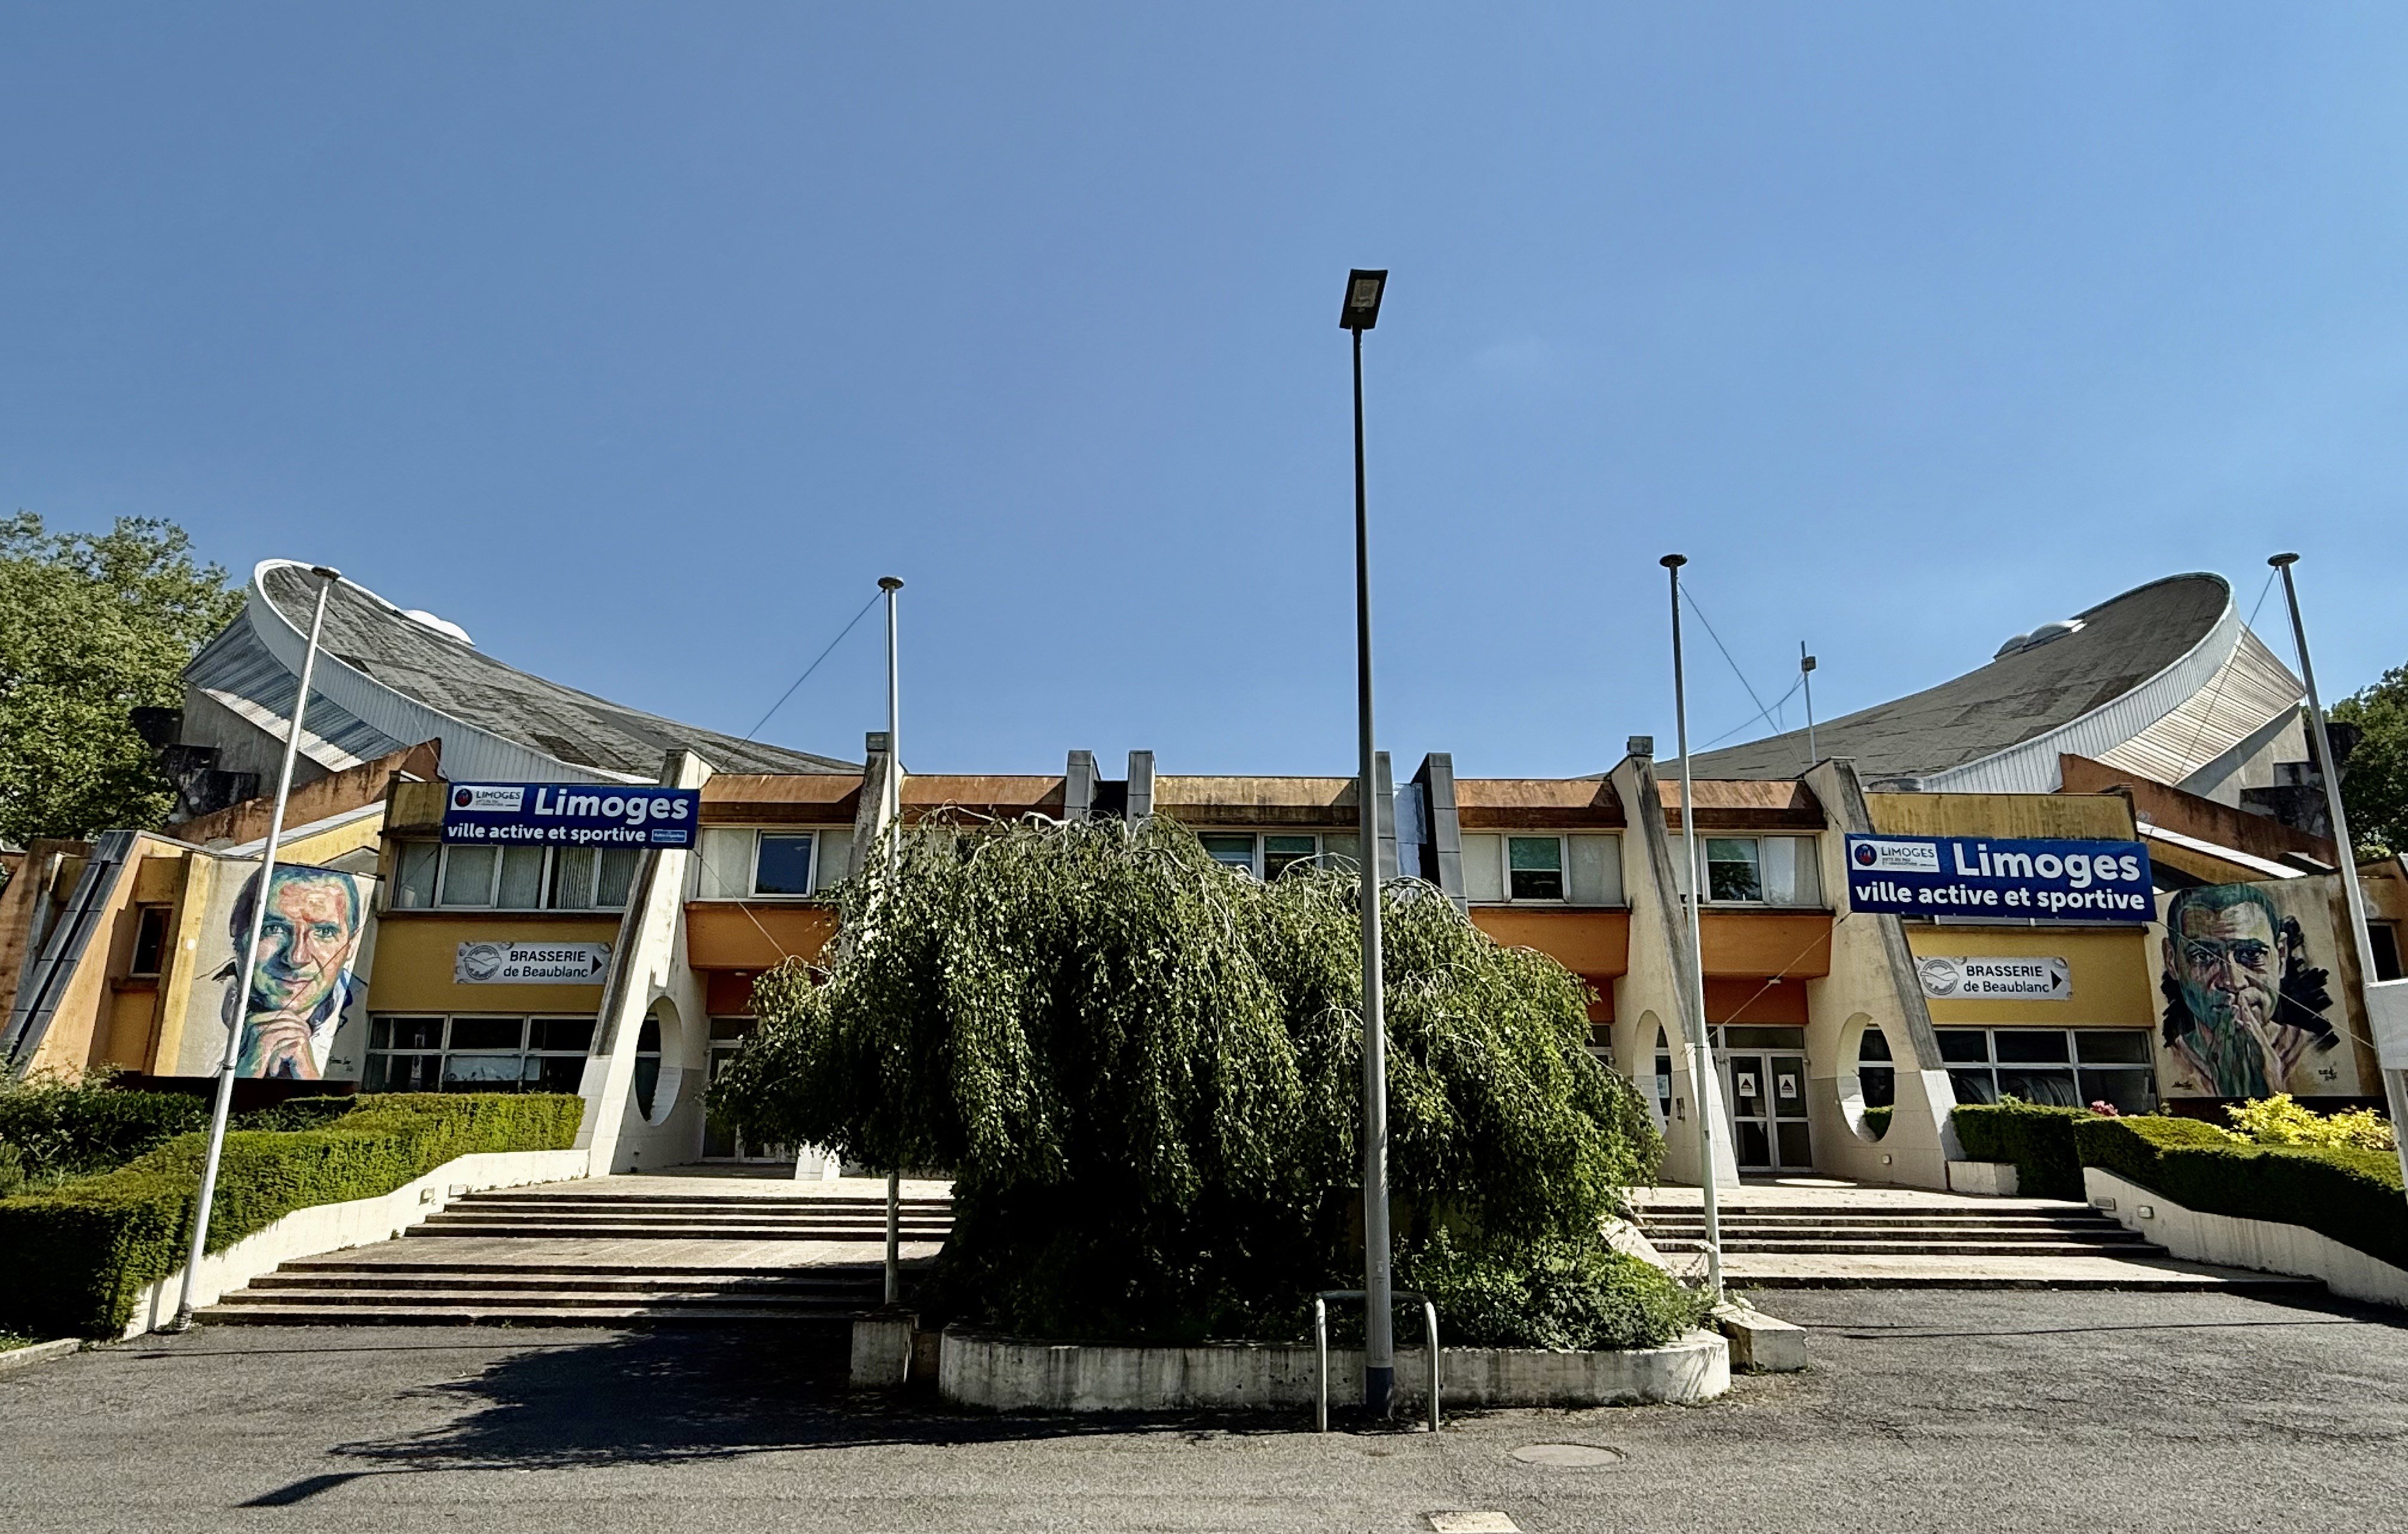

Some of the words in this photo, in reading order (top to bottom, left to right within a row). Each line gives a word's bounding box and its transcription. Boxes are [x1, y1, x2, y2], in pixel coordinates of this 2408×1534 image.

[476, 791, 521, 800] LIMOGES
[534, 787, 689, 825] Limoges
[448, 823, 485, 838] ville
[489, 824, 544, 839] active
[548, 826, 567, 840] et
[570, 826, 647, 844] sportive
[1881, 847, 1935, 858] LIMOGES
[1953, 842, 2141, 888] Limoges
[1855, 881, 1913, 903] ville
[1918, 884, 1998, 906] active
[2005, 887, 2031, 906] et
[2037, 888, 2146, 913] sportive
[509, 951, 586, 962] BRASSERIE
[503, 965, 519, 977] de
[522, 965, 588, 977] Beaublanc
[1966, 965, 2043, 977] BRASSERIE
[1963, 980, 1979, 992] de
[1982, 980, 2050, 993] Beaublanc
